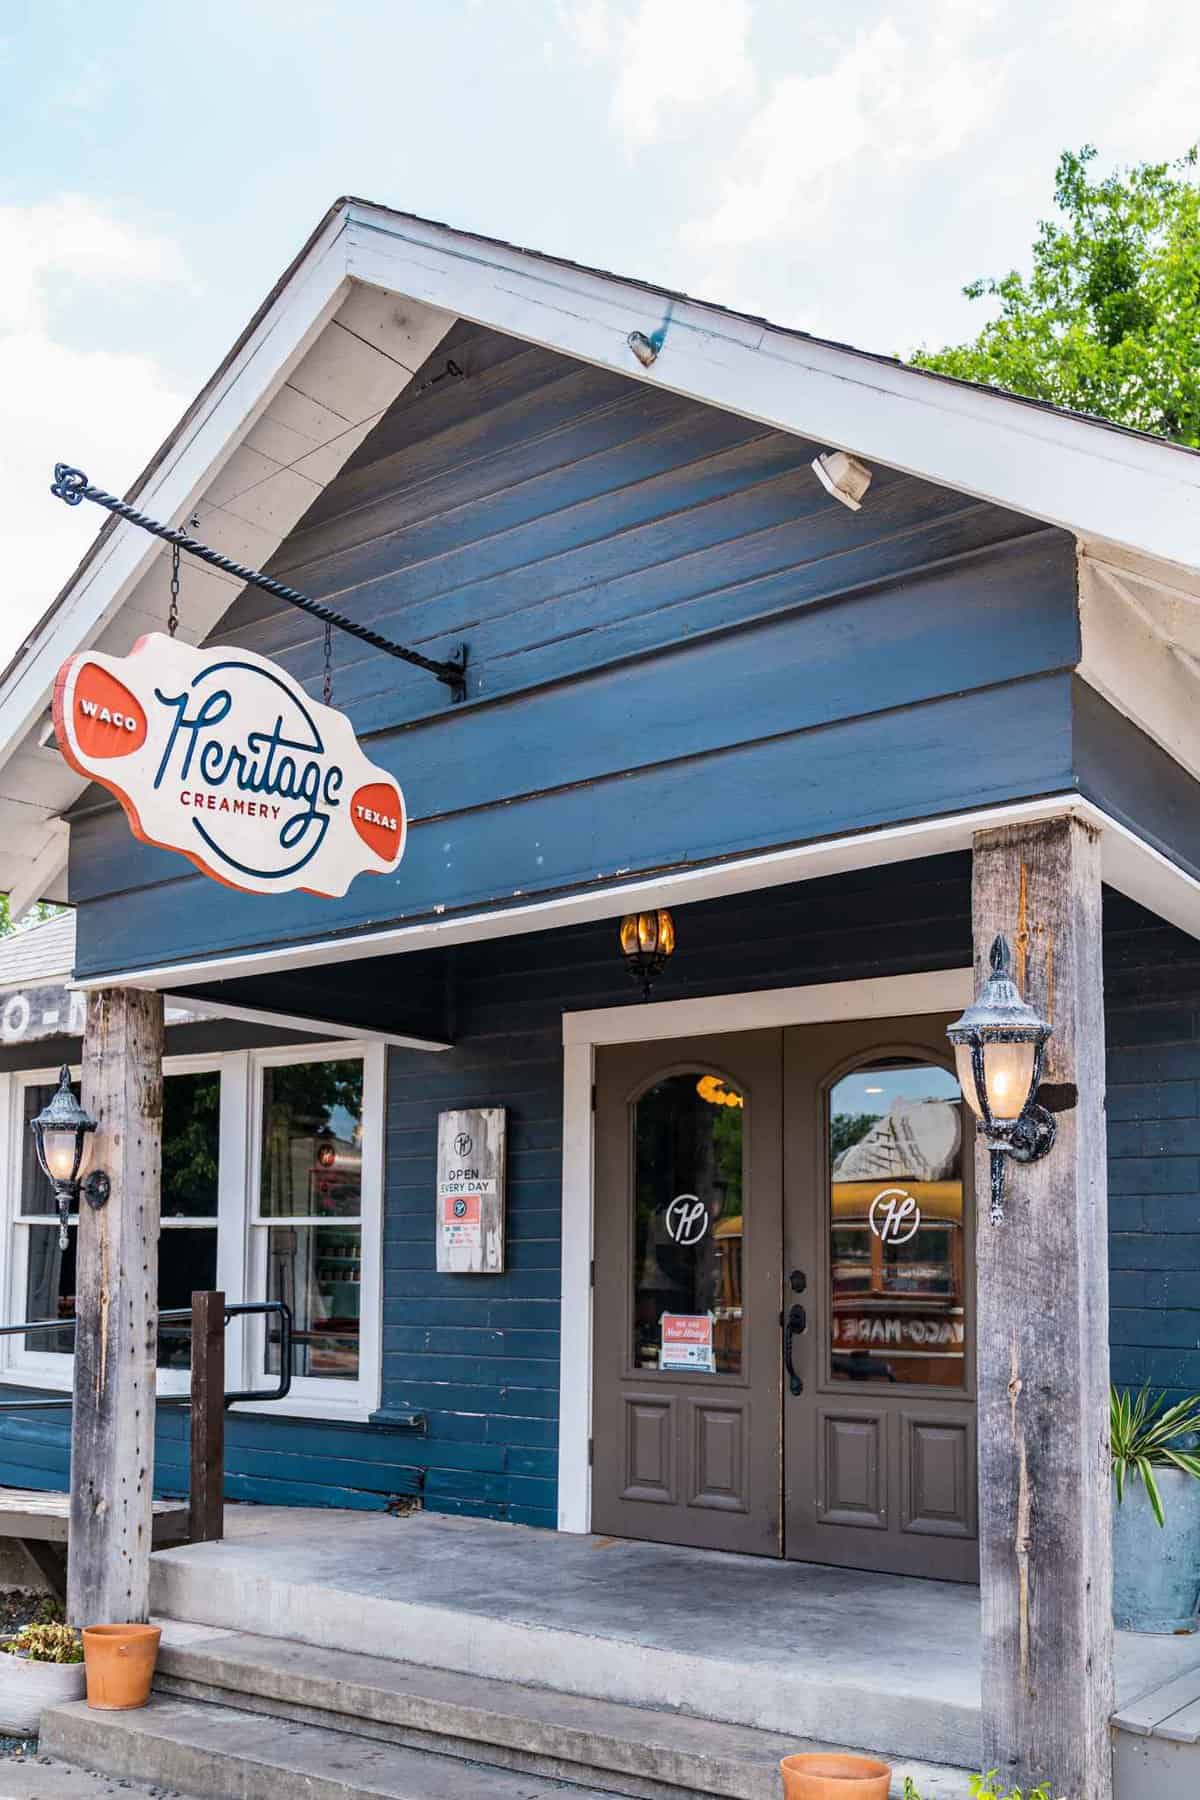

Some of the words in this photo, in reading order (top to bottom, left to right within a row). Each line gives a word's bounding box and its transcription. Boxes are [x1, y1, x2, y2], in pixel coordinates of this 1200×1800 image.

[80, 699, 138, 733] WACO
[154, 688, 344, 849] Heritage
[179, 790, 281, 820] CREAMERY
[355, 805, 398, 831] TEXAS
[441, 1183, 465, 1193] EVERY
[467, 1182, 489, 1192] DAY
[448, 1168, 479, 1181] OPEN
